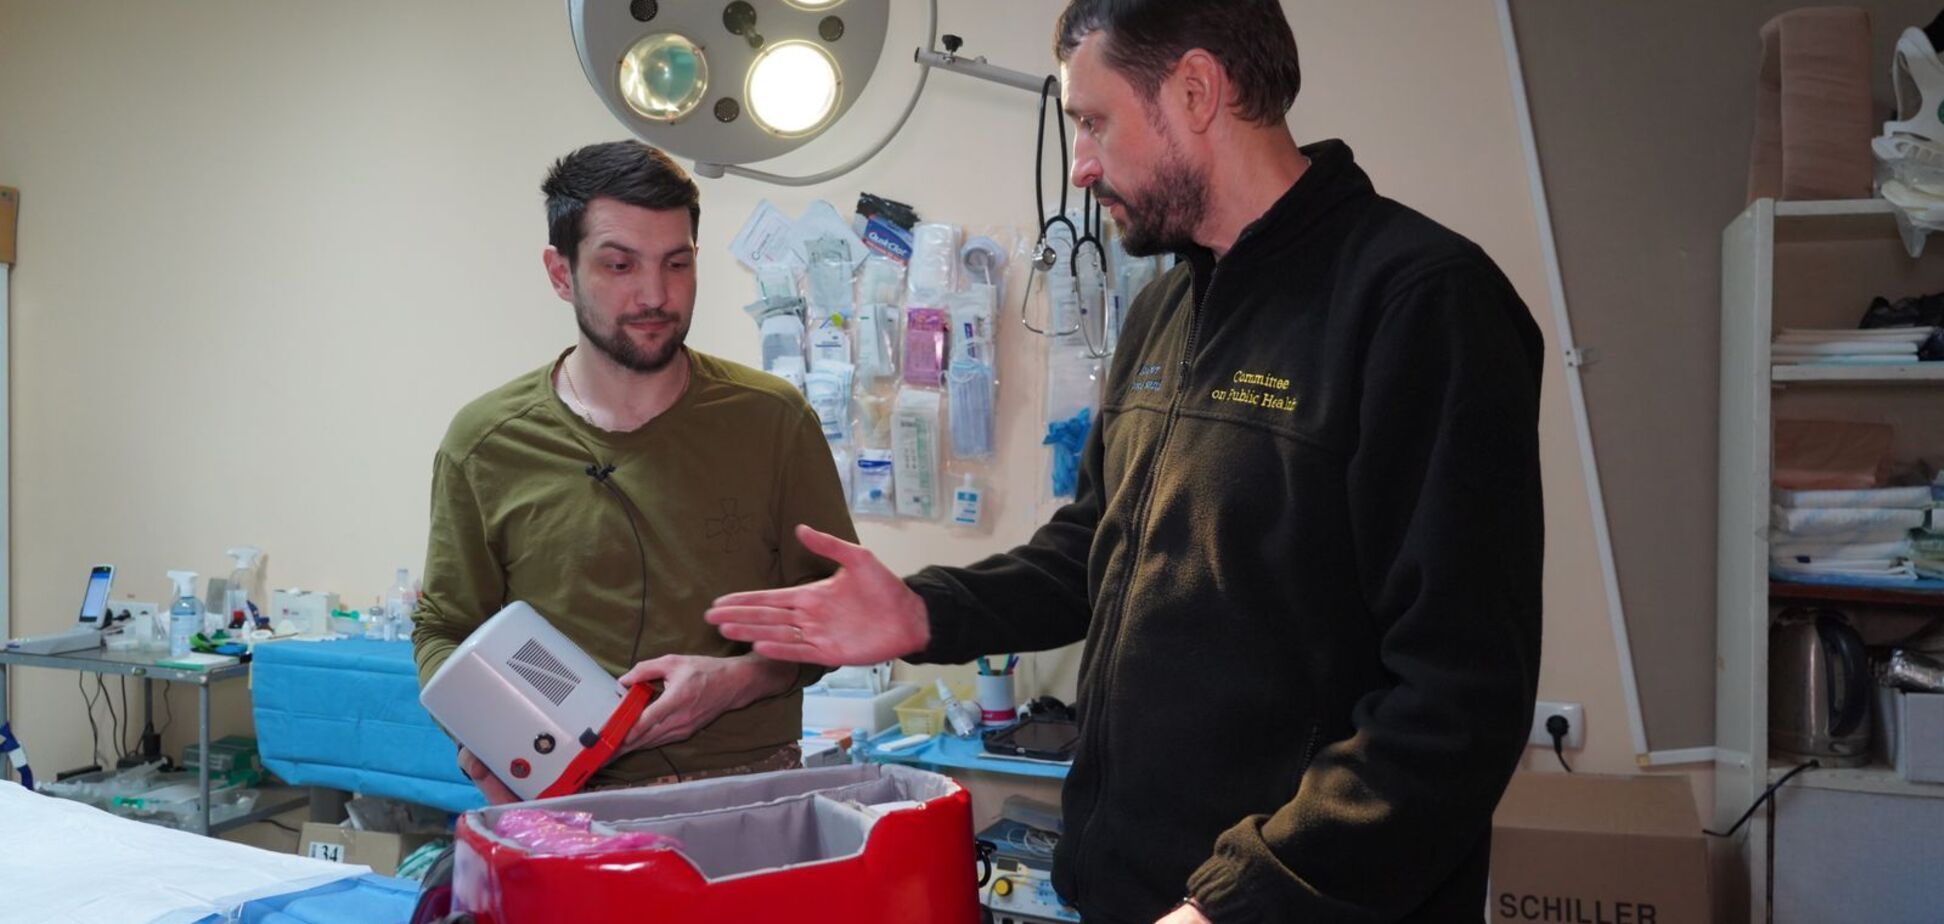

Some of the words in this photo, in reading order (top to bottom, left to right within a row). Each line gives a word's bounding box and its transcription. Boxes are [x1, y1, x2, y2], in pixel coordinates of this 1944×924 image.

[1233, 370, 1290, 390] Committee
[1211, 389, 1226, 400] on
[1228, 388, 1260, 405] Public
[1261, 392, 1297, 411] Health
[1500, 893, 1657, 924] SCHILLER
